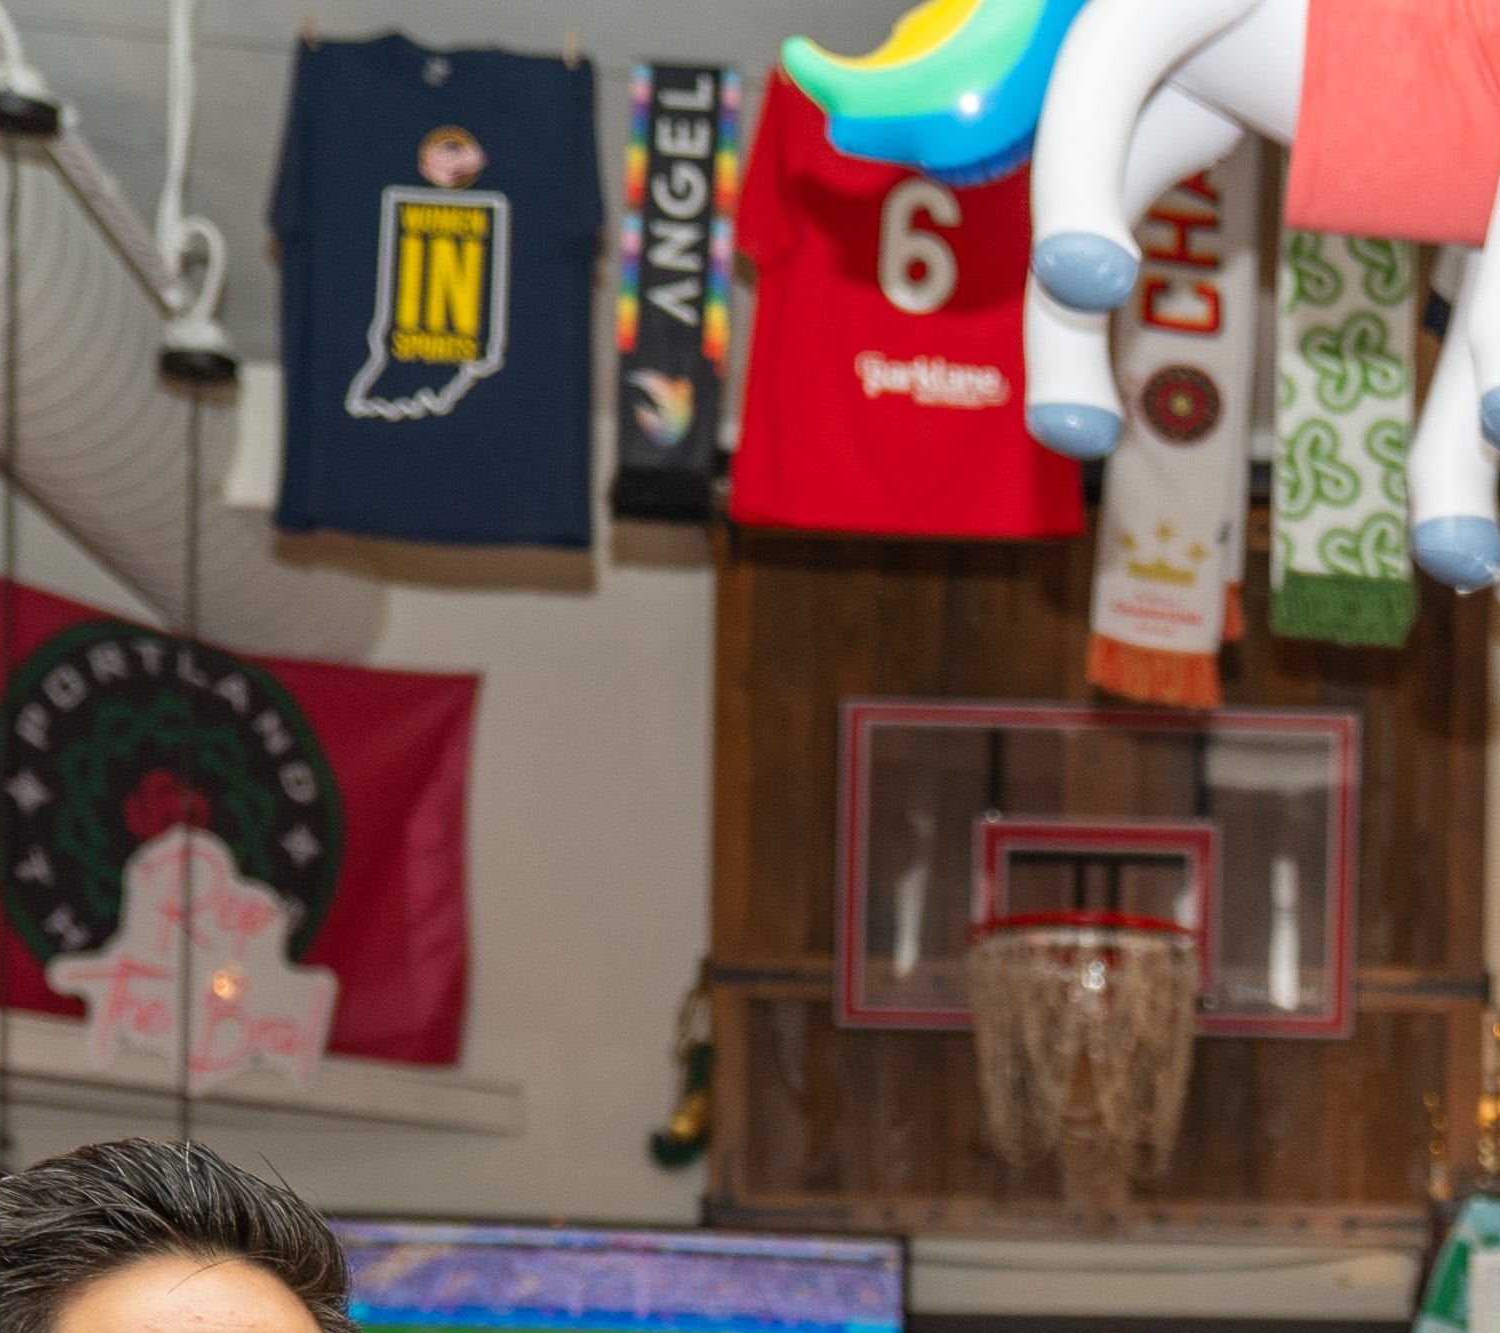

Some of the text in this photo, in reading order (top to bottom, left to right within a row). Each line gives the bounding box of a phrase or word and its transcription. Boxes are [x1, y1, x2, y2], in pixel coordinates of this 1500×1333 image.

[645, 72, 716, 328] ANGEL
[877, 176, 963, 315] 6
[398, 236, 484, 337] IN
[15, 639, 318, 804] PORTLAND
